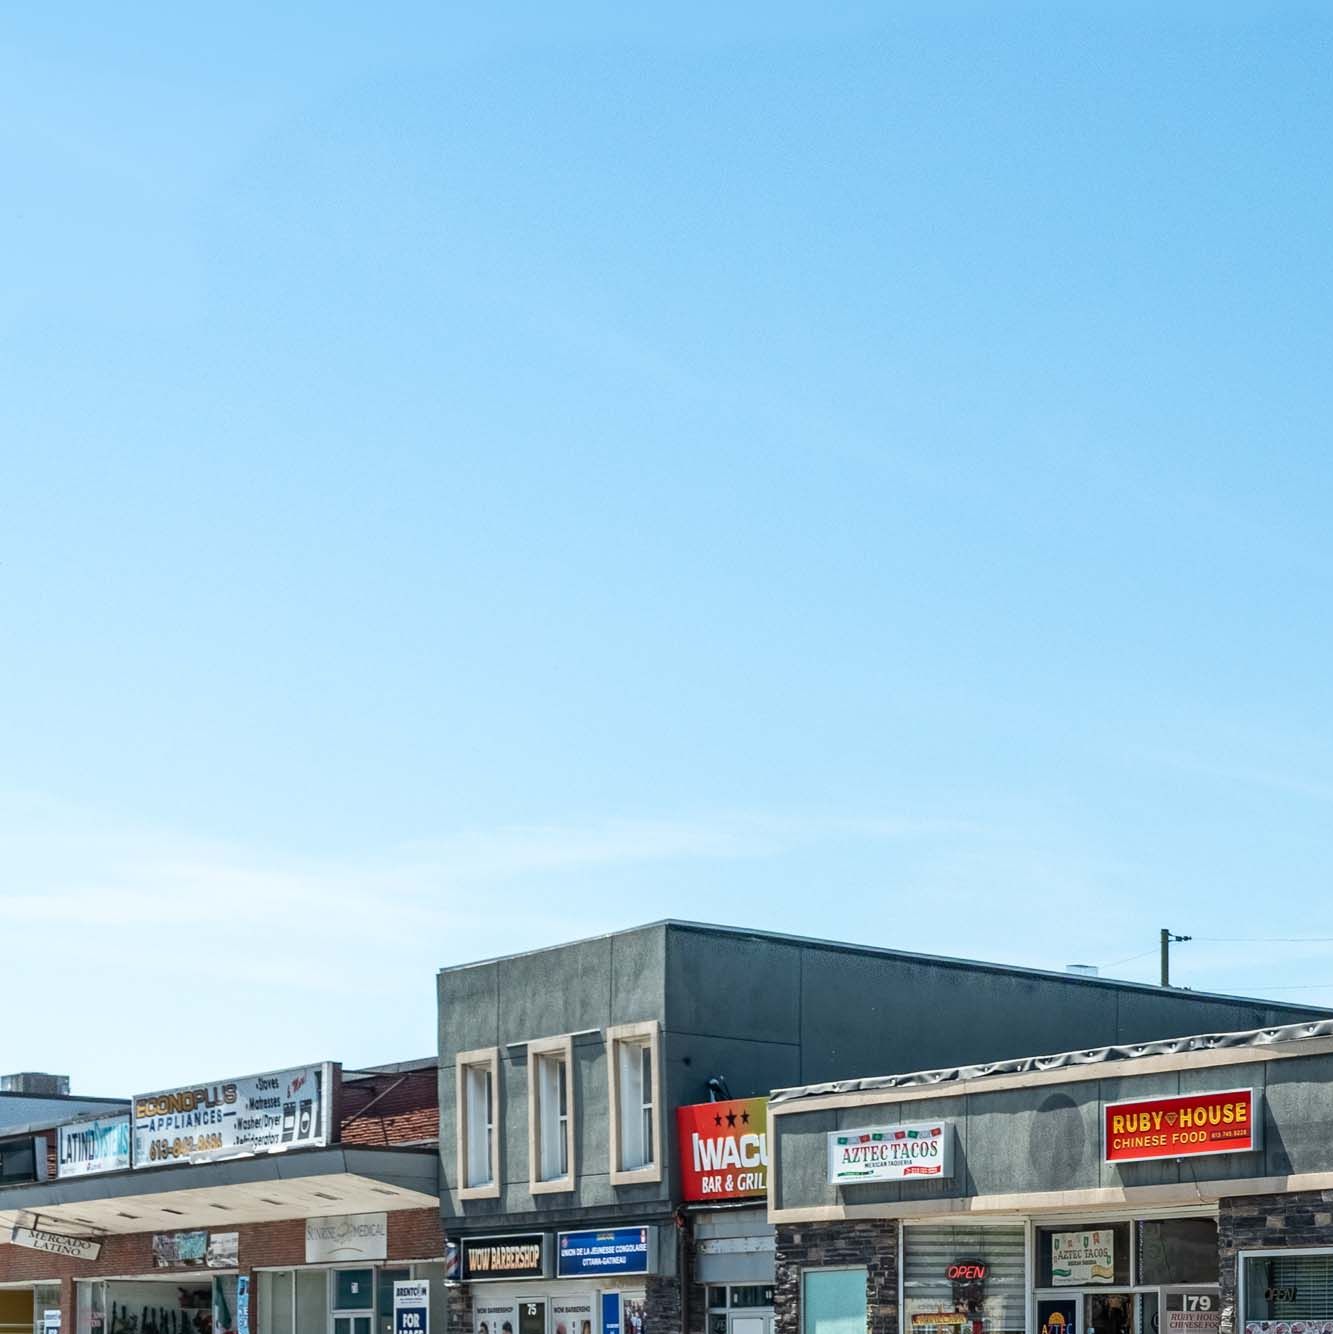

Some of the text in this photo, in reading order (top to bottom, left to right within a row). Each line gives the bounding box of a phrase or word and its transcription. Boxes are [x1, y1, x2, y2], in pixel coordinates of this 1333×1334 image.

[136, 1083, 238, 1119] ECONOPLUS
[149, 1109, 223, 1132] APPLIANCES
[1113, 1102, 1247, 1134] RUBY HOUSE
[1113, 1135, 1167, 1150] CHINESE
[1172, 1131, 1207, 1144] FOOD
[842, 1140, 938, 1164] AZTEC TACOS
[702, 1172, 768, 1194] BAR & GRIL
[28, 1229, 91, 1249] MERCADO
[351, 1223, 385, 1238] MEDICAL
[33, 1239, 81, 1256] LATINO
[1085, 1247, 1108, 1258] TACOS
[468, 1244, 540, 1271] WOW BARBERSHOP
[948, 1265, 986, 1279] OPEN
[527, 1303, 537, 1315] 75
[1171, 1313, 1220, 1321] RUBY HOUS
[403, 1313, 420, 1328] FOR
[1170, 1321, 1203, 1329] CHINESE
